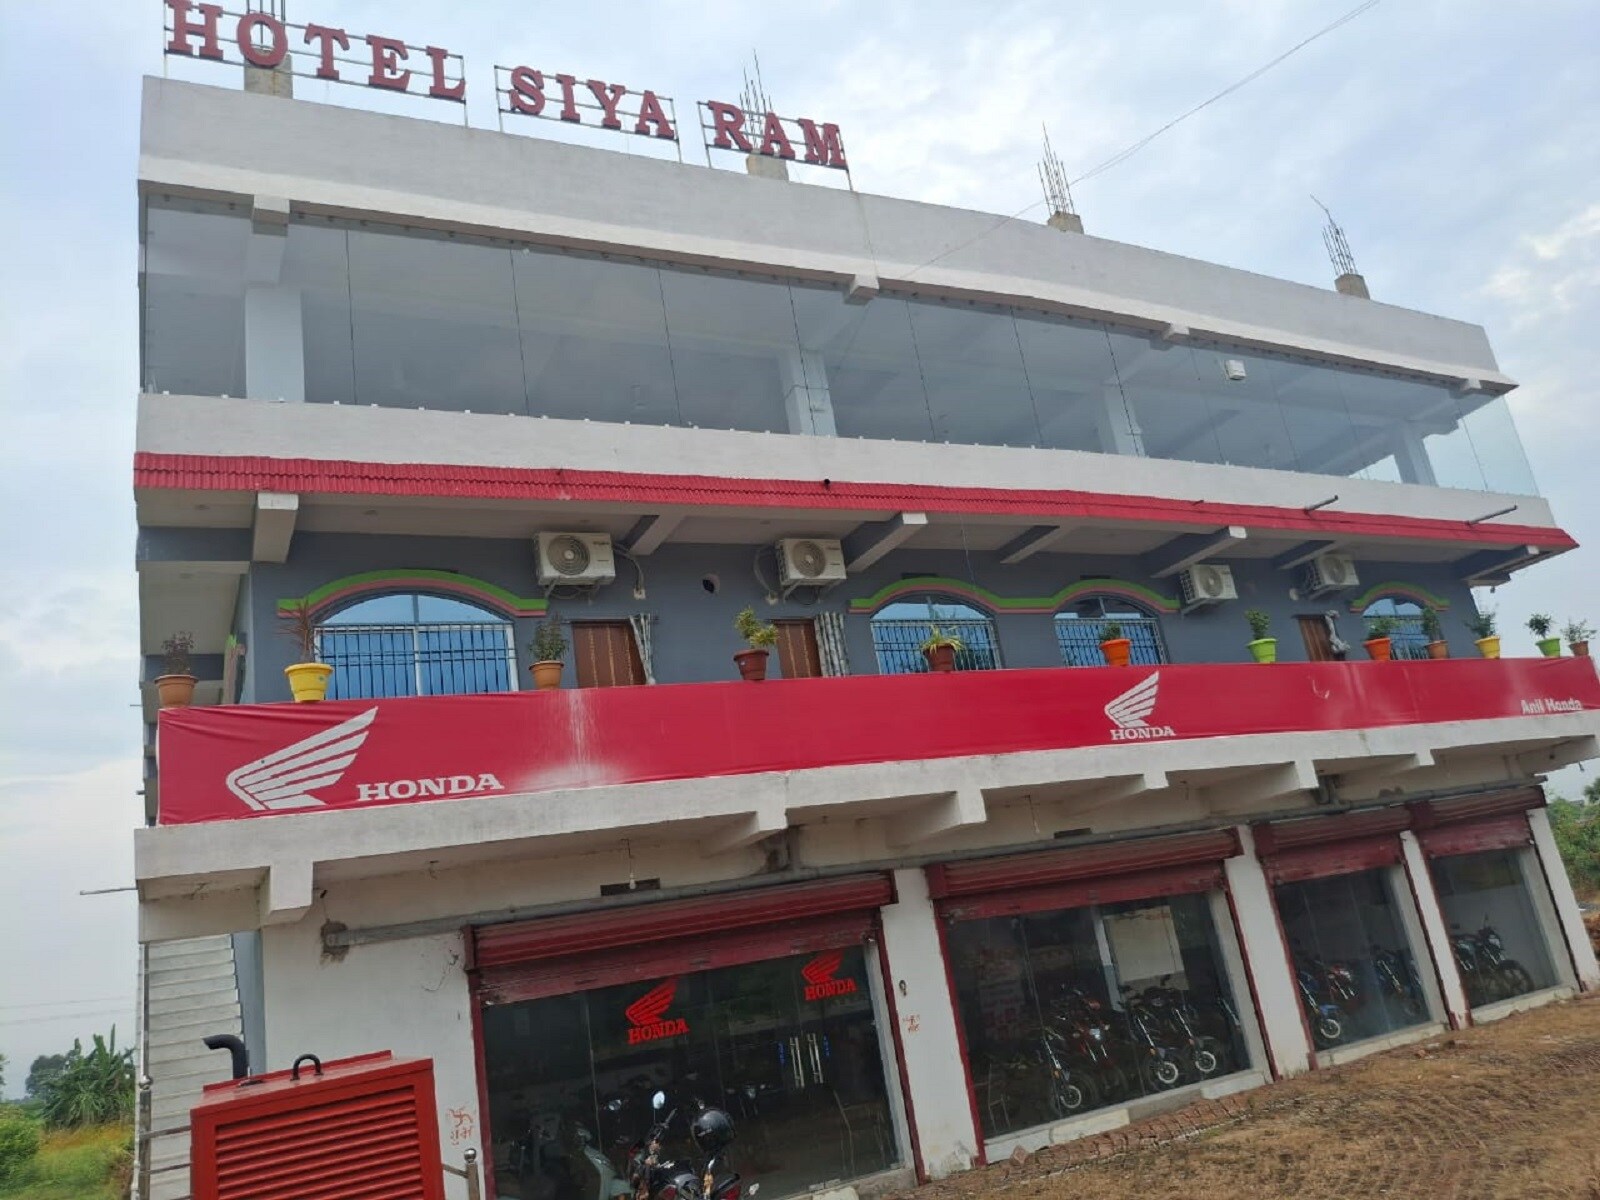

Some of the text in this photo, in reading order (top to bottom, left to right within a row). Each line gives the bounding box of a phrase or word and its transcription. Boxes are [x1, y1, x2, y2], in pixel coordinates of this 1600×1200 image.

[166, 0, 848, 168] HOTEL SIYA RAM
[1520, 699, 1545, 715] Anil
[1110, 726, 1176, 740] HONDA
[355, 773, 505, 801] HONDA
[804, 977, 857, 1001] HONDA
[628, 1018, 690, 1045] HONDA
